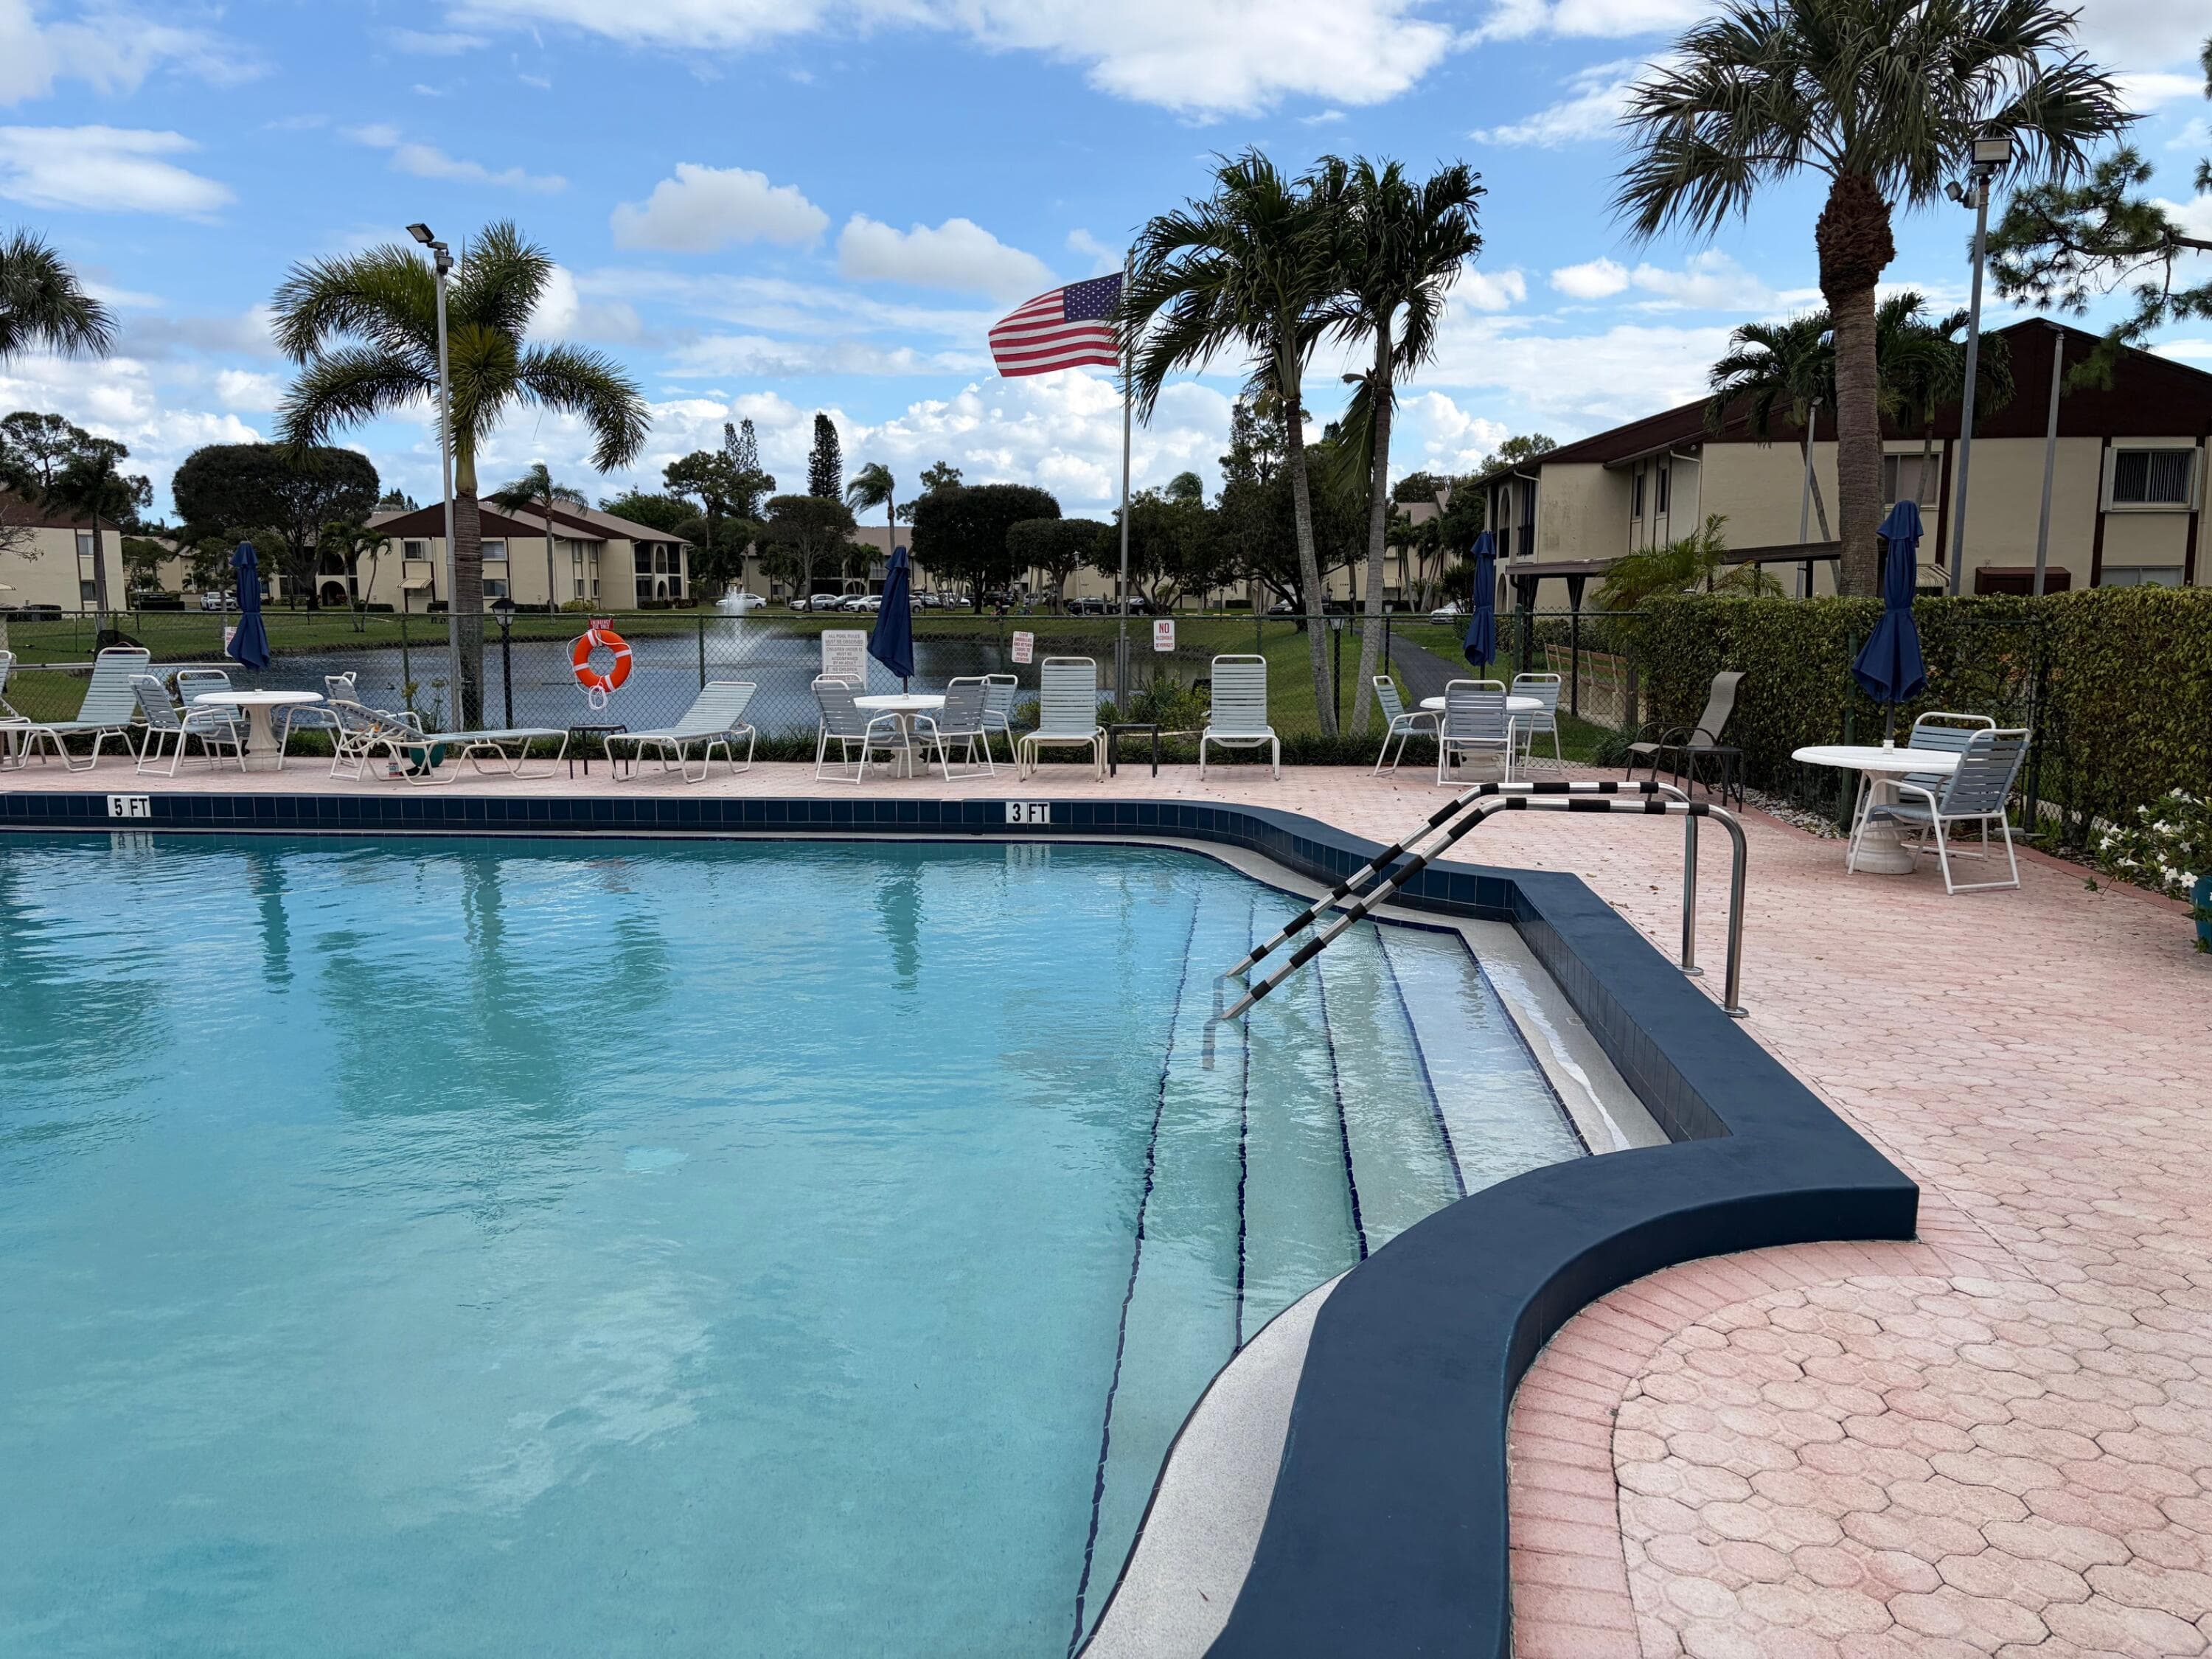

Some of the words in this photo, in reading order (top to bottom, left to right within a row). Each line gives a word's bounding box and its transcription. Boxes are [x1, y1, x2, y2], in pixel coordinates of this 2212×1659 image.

[1159, 623, 1169, 633] NO
[114, 799, 123, 816] 5
[130, 799, 147, 816] FT
[1012, 803, 1021, 822] 3
[1029, 803, 1048, 822] FT
